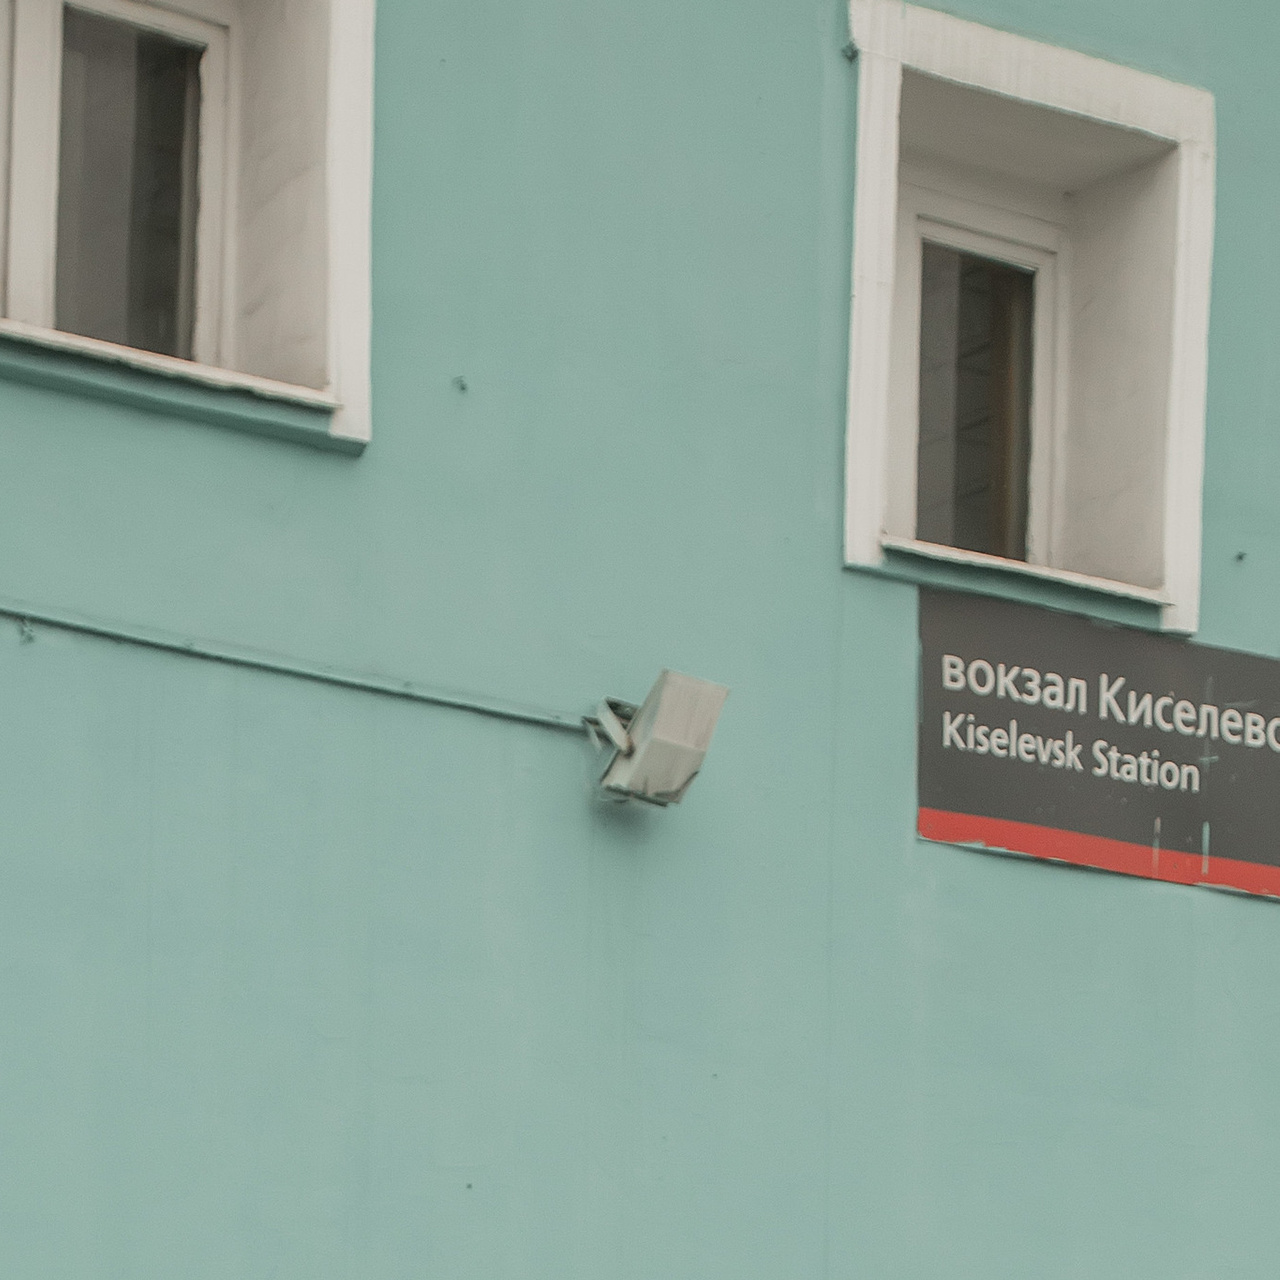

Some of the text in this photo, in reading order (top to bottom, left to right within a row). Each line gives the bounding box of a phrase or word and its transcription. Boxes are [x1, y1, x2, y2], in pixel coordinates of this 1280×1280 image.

[942, 654, 1087, 715] вокзал
[942, 711, 1200, 792] Kiselevsk Station
